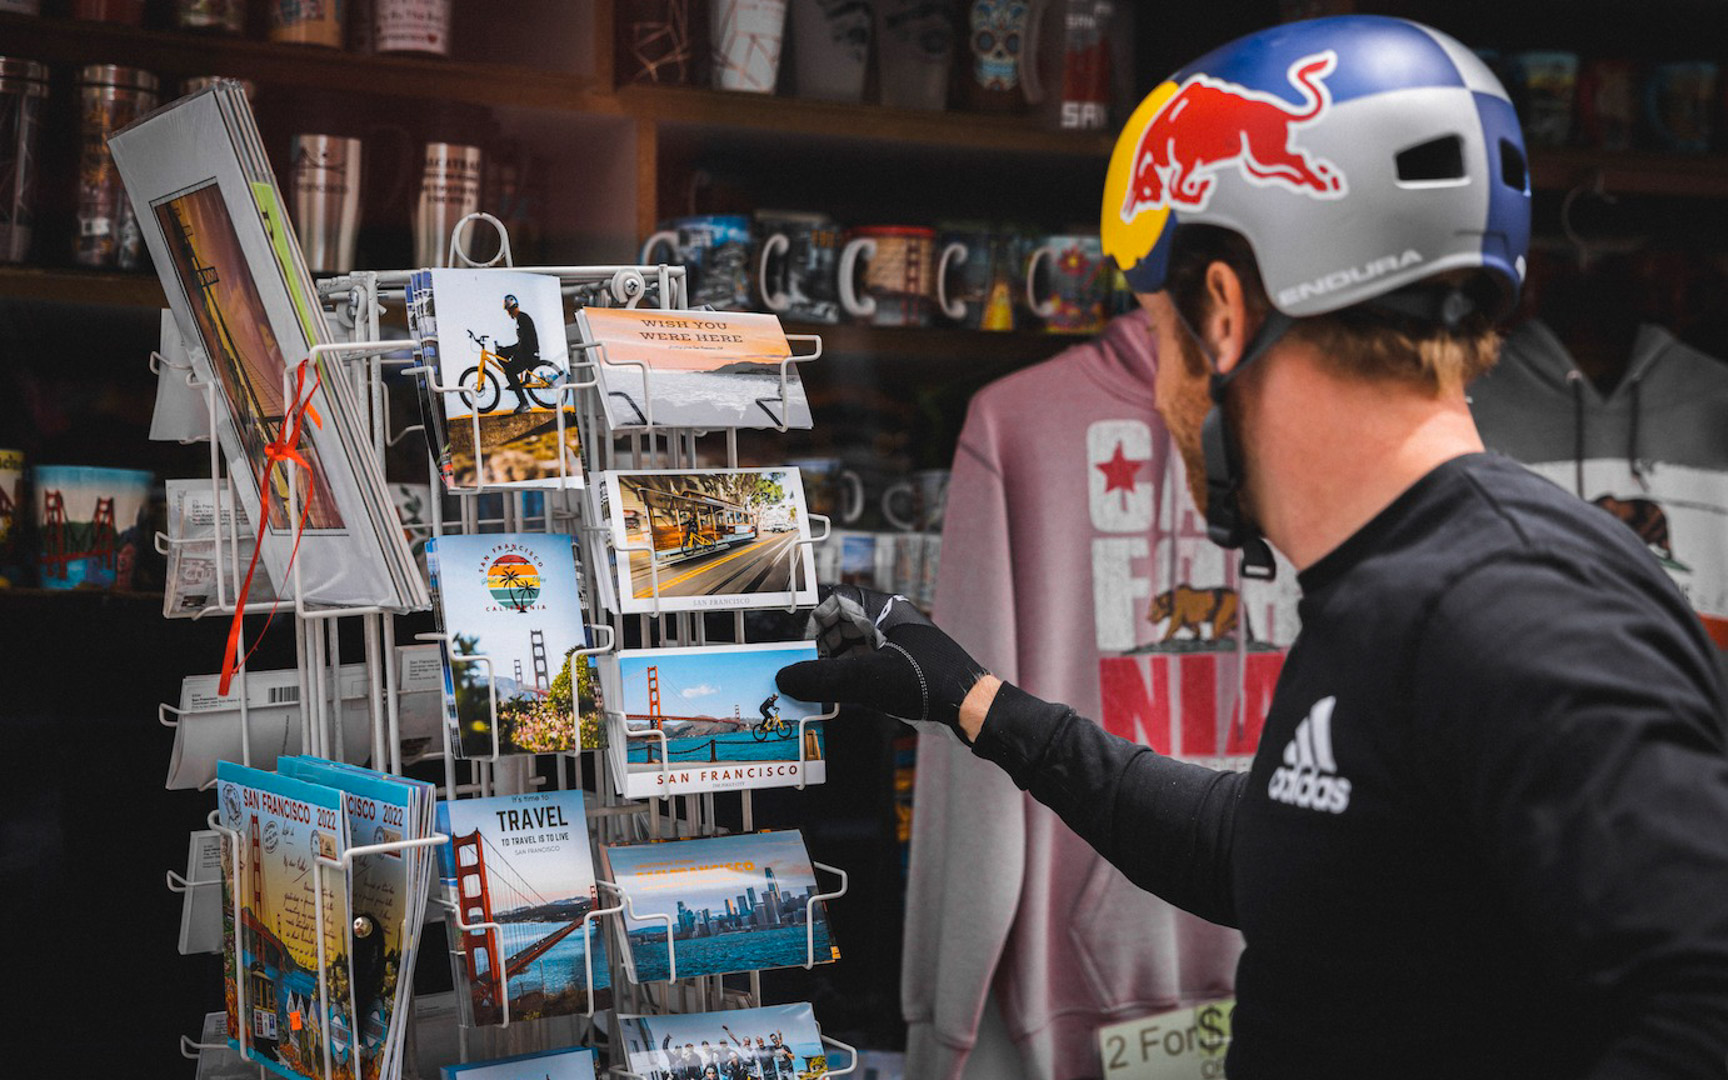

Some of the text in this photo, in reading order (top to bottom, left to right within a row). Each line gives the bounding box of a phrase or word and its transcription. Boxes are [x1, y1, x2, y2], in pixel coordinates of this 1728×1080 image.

[1279, 249, 1422, 306] ENDURA
[640, 319, 728, 330] WISH YOU
[639, 331, 743, 343] WERE HERE
[479, 543, 544, 573] SAN FRANCISCO
[486, 604, 546, 612] CALIFORNIA
[693, 597, 751, 606] SAN FRANCISCO
[656, 764, 798, 785] SAN FRANCISCO
[1267, 766, 1353, 815] adidas
[242, 788, 260, 811] SAN
[262, 793, 310, 825] FRANCISCO
[316, 807, 337, 831] 2022
[382, 804, 404, 827] 2022
[496, 805, 568, 832] TRAVEL
[501, 832, 569, 847] TO TRAVEL IS TO LIVE
[514, 845, 561, 856] SAN FRANCISCO
[1106, 1035, 1130, 1070] 2
[1139, 1026, 1199, 1063] For
